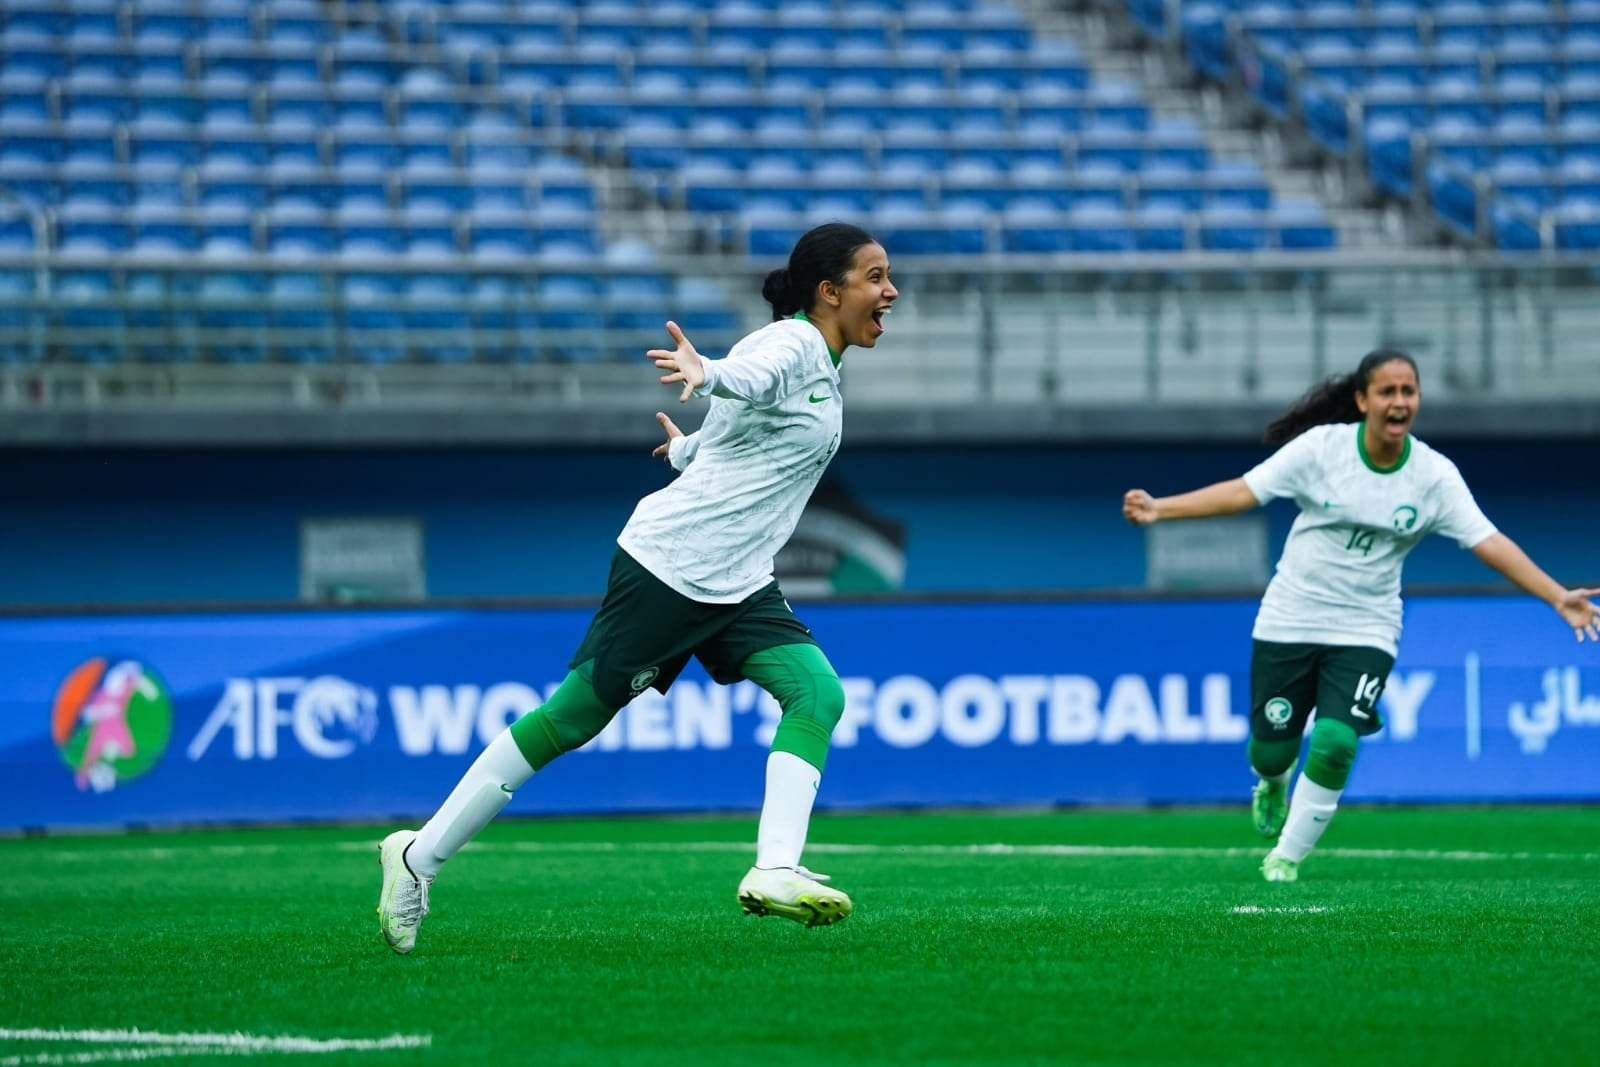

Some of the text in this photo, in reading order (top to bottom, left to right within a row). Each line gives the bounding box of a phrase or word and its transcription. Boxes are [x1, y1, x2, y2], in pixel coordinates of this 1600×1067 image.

[1346, 527, 1375, 556] 14
[1354, 672, 1380, 709] 14
[187, 674, 377, 761] AFC
[389, 679, 784, 756] WOEN'
[832, 673, 1249, 748] FOOTBALL
